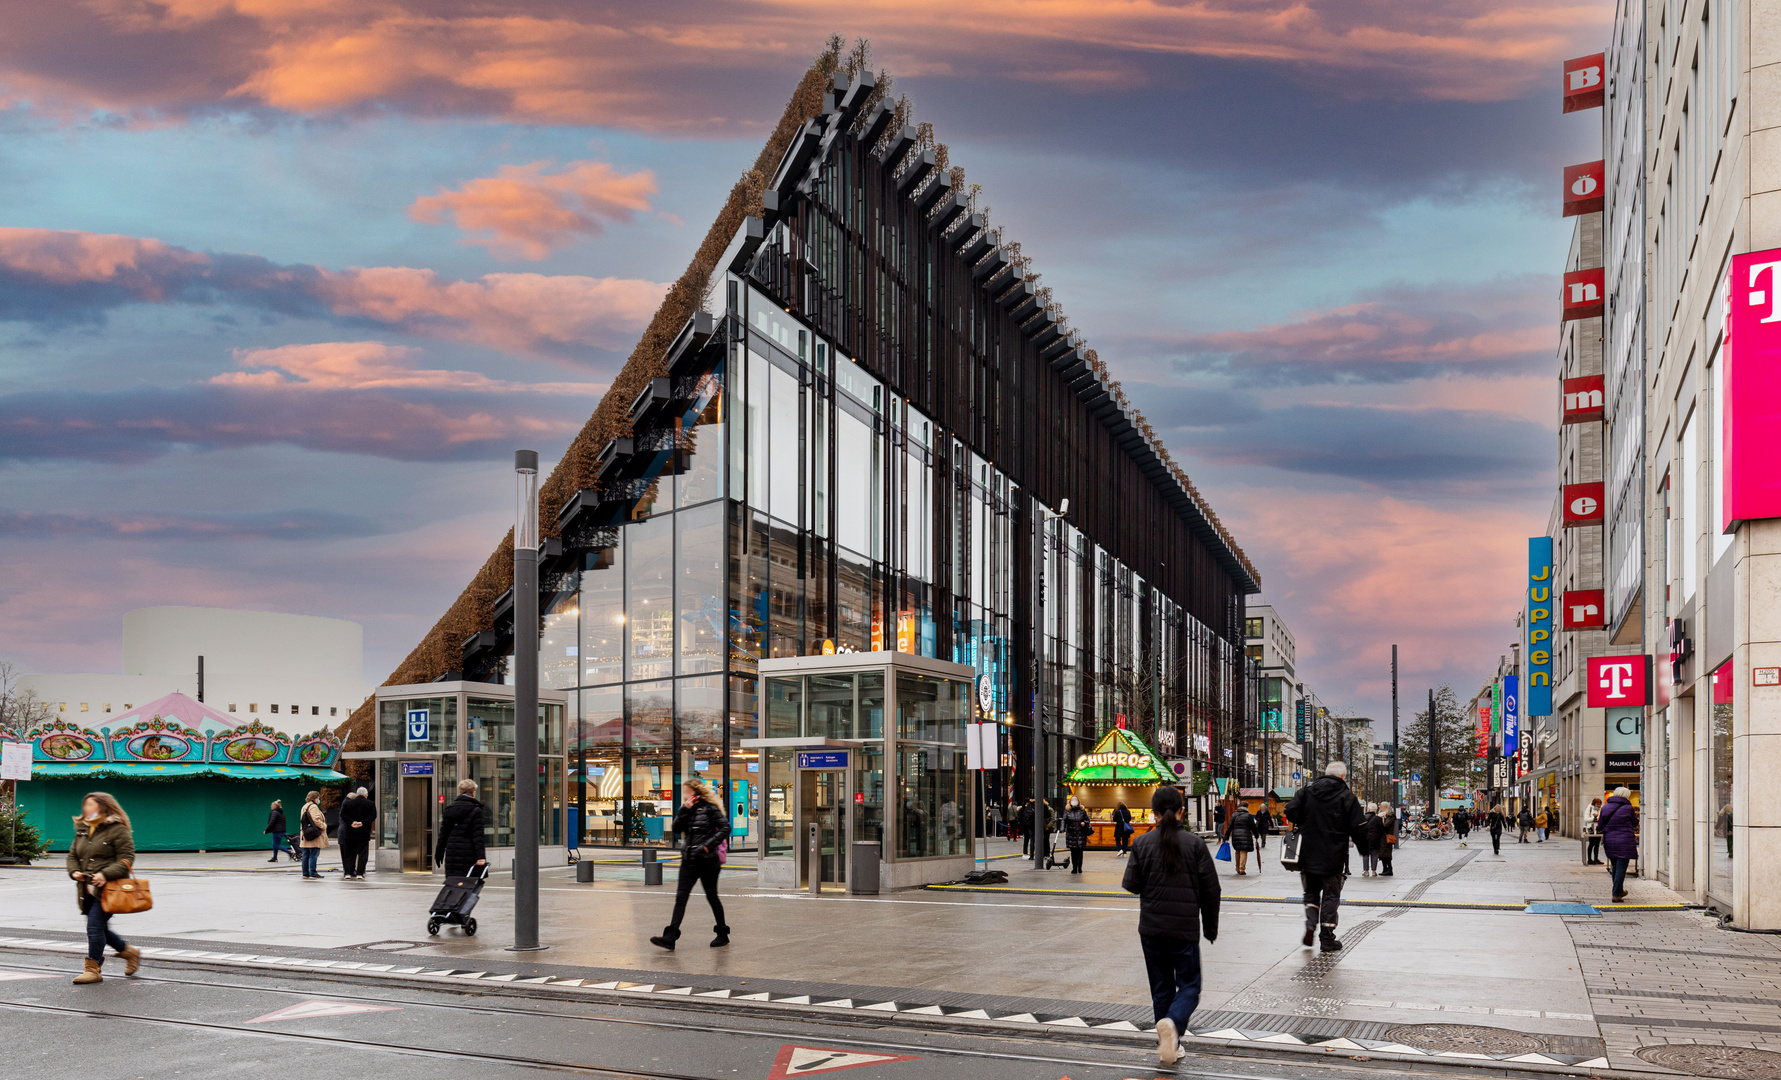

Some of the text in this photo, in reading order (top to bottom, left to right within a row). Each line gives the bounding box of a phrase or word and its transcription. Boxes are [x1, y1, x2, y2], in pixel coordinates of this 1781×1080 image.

[1600, 663, 1632, 699] T
[411, 713, 425, 738] U
[1505, 713, 1514, 737] APOLLO
[1076, 752, 1151, 770] CHURROS
[1521, 731, 1532, 770] orsay
